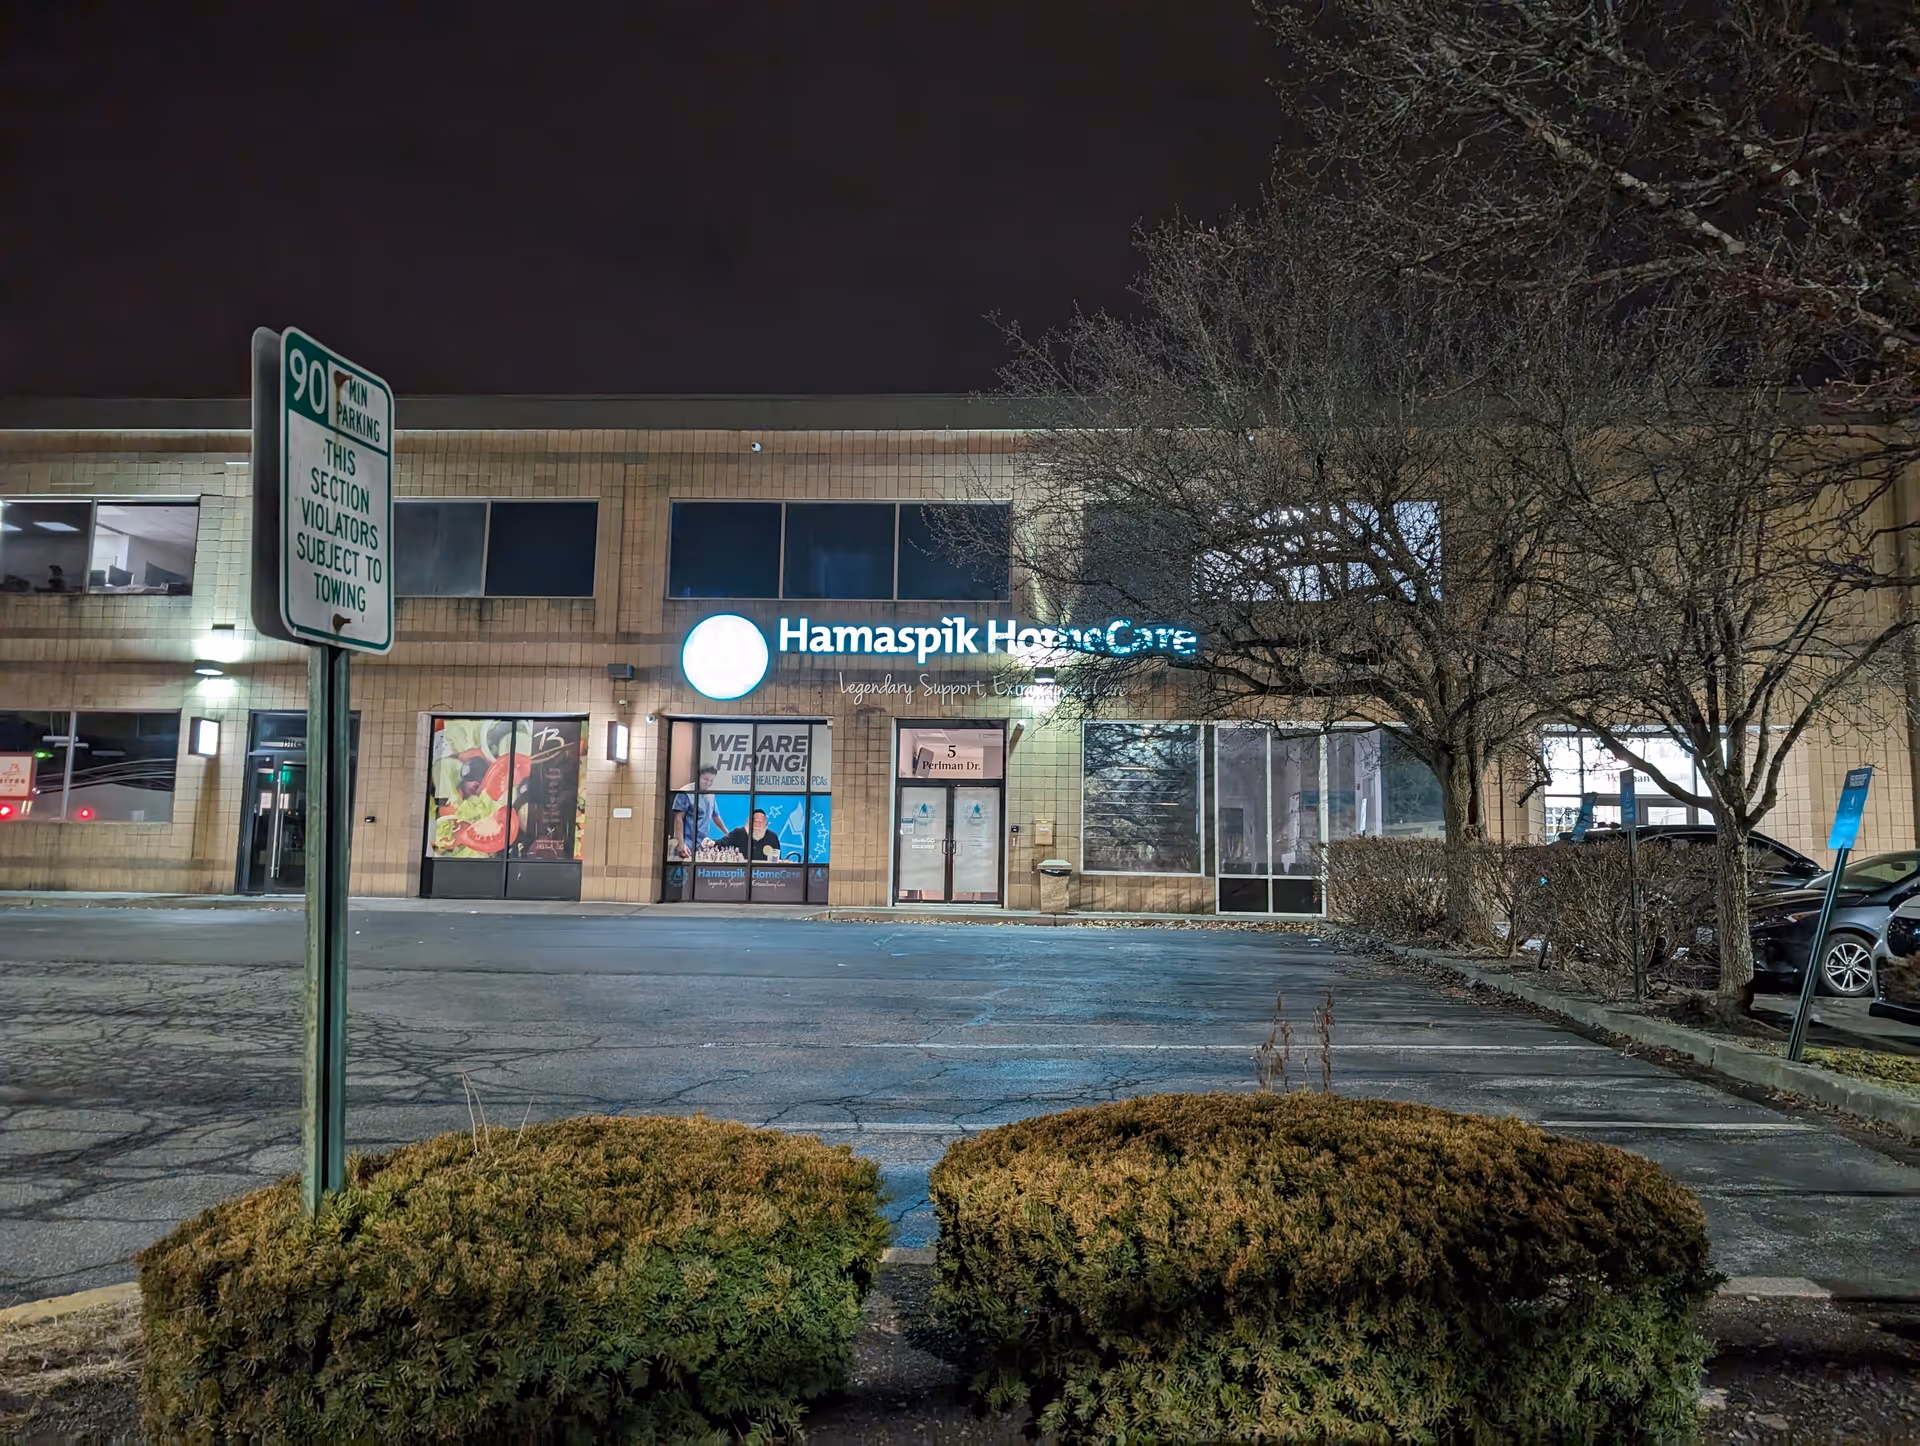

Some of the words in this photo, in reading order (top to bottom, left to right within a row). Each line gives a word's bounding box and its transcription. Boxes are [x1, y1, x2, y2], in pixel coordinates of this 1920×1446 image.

[290, 348, 327, 415] 90
[349, 379, 368, 408] MIN
[336, 400, 381, 443] PARKING
[325, 437, 356, 477] THIS
[311, 467, 370, 516] SECTION
[301, 496, 378, 551] VIOLATORS
[296, 531, 360, 578] SUBJECT
[366, 554, 382, 585] TO
[314, 571, 367, 614] TOWING
[779, 616, 979, 664] Hamaspik
[839, 671, 914, 706] Legendary
[919, 673, 987, 706] Support,
[709, 734, 750, 752] WE
[756, 734, 809, 753] ARE
[947, 744, 957, 758] 5
[716, 753, 809, 773] HIRING!
[732, 775, 751, 785] HOME
[756, 775, 780, 786] HEALTH
[781, 775, 800, 786] AIDES
[800, 775, 806, 786] &
[812, 775, 828, 786] PCAs
[922, 760, 964, 771] Perlman
[966, 761, 981, 771] Dr.
[697, 868, 746, 880] Hamaspik
